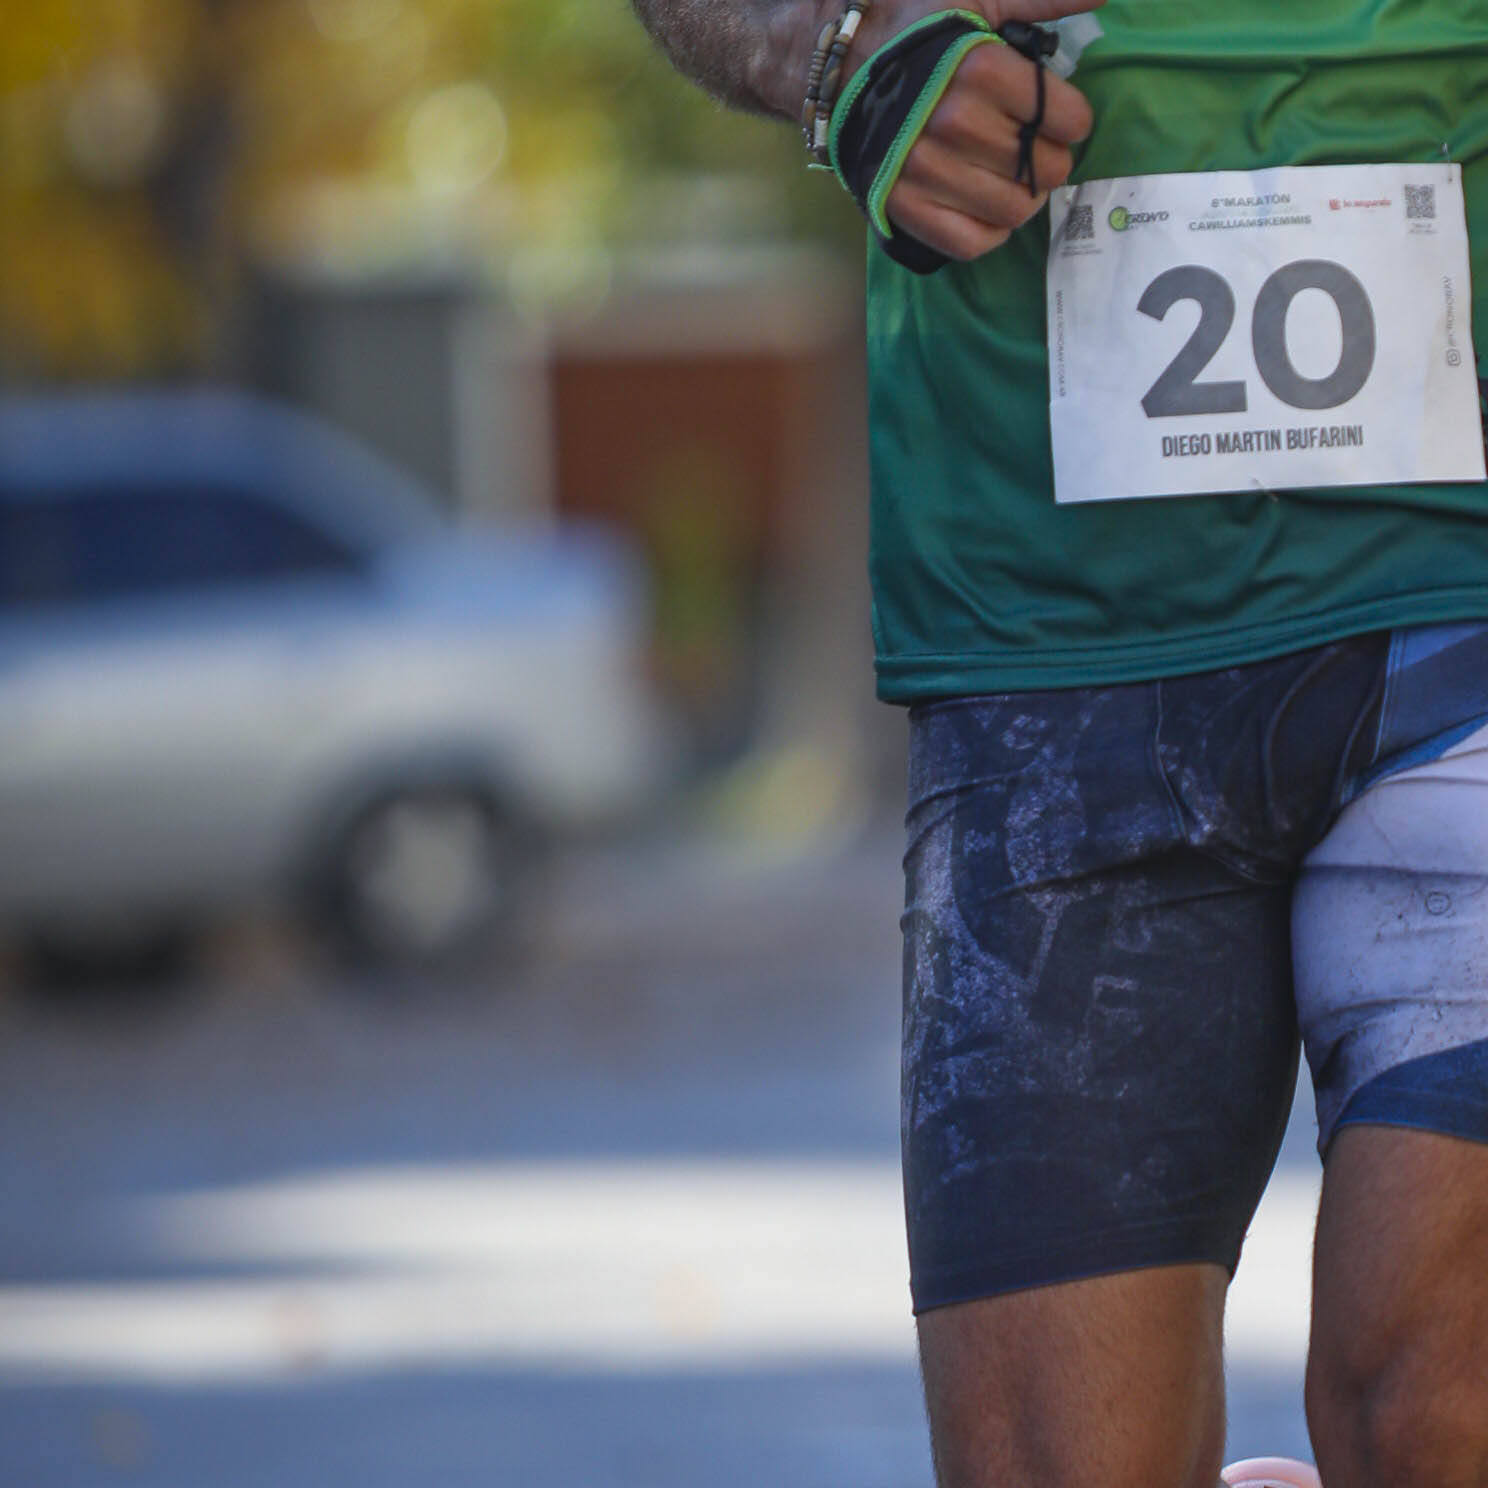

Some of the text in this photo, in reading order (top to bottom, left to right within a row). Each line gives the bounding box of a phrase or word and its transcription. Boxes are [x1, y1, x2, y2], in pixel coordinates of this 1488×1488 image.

[1136, 258, 1376, 418] 20
[1162, 424, 1364, 458] DIEGO MARTIN BUFARINI
